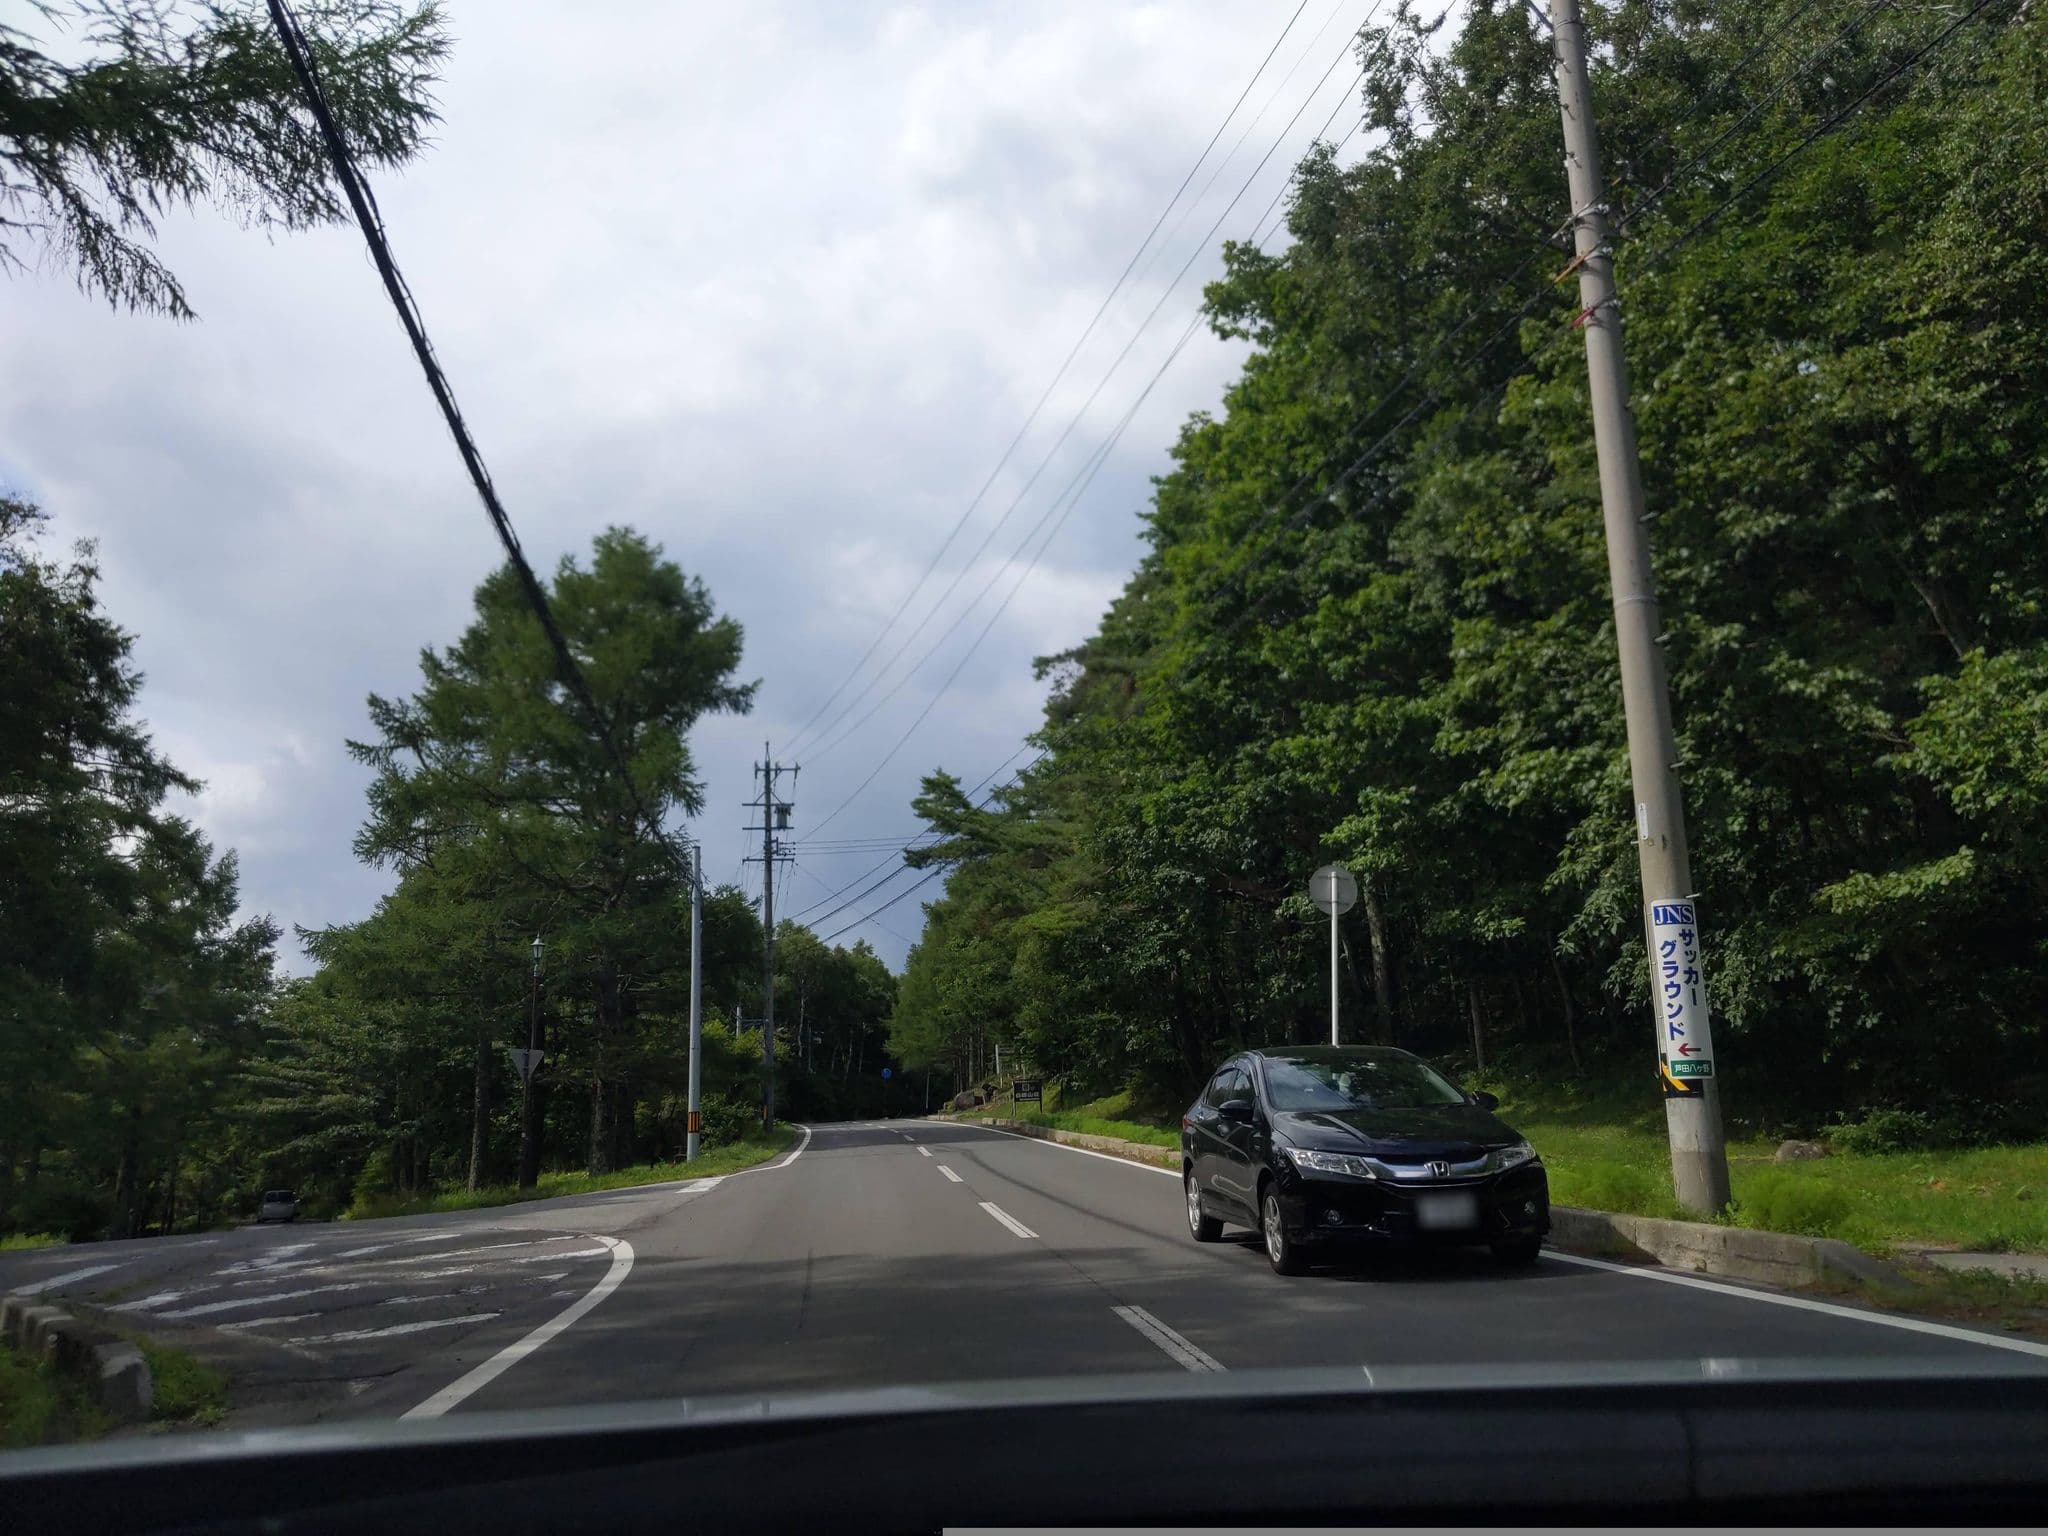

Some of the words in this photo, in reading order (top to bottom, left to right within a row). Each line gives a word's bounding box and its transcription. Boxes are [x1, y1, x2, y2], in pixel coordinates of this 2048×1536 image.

[1655, 905, 1694, 925] JNS
[1660, 940, 1685, 1041] グラウンド
[1679, 928, 1699, 1006] サッカー
